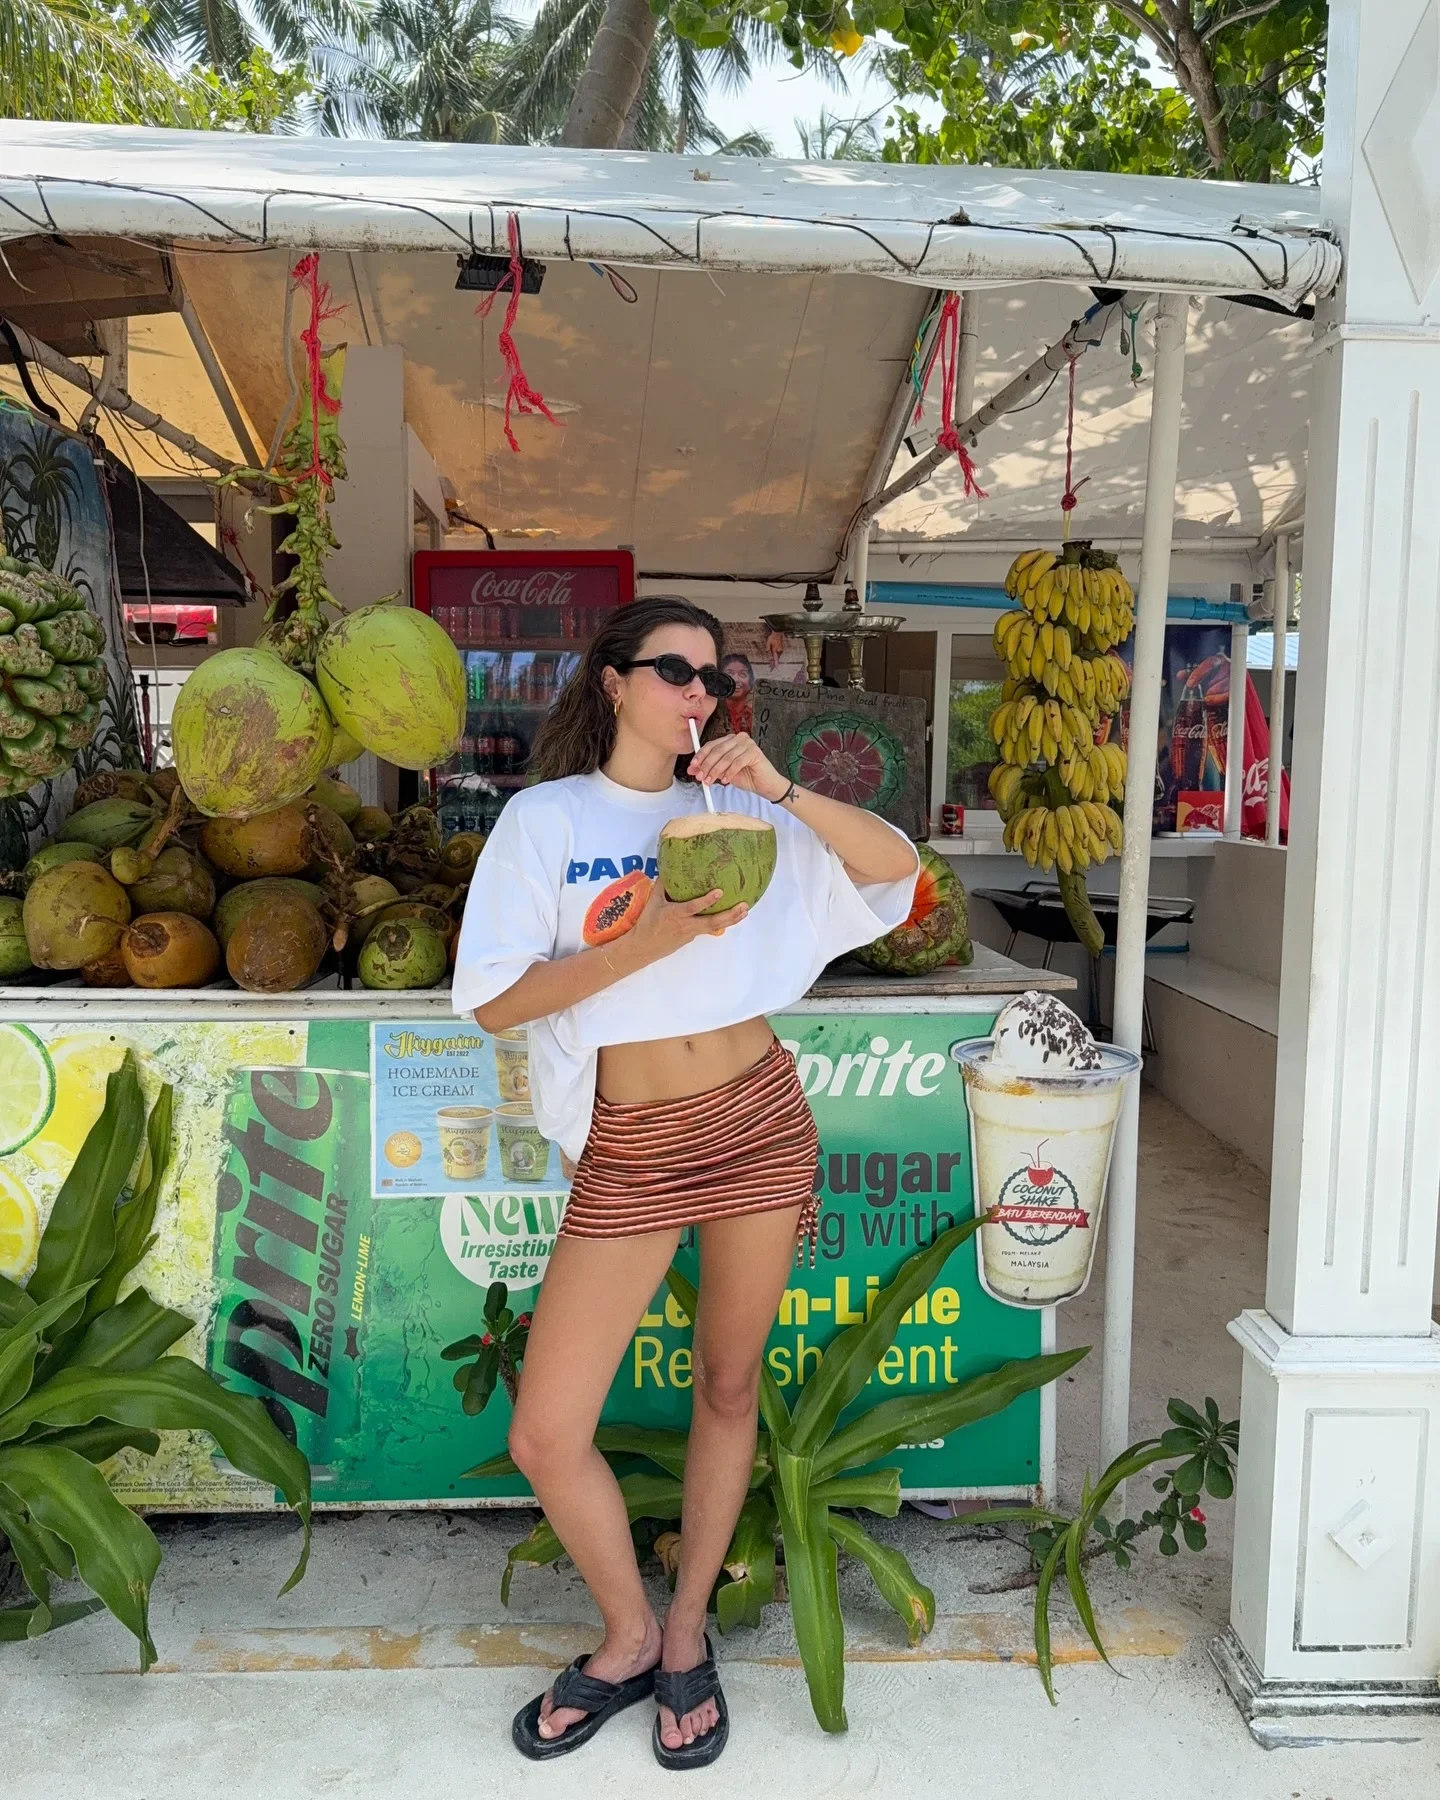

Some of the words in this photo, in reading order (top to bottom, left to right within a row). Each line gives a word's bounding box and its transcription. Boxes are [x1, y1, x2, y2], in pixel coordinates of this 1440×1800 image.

[470, 571, 577, 606] Coca-Cola
[758, 681, 811, 699] Screw
[813, 686, 846, 702] Pine
[855, 694, 878, 706] local
[387, 1066, 480, 1080] HOMEMADE
[392, 1084, 417, 1097] ICE
[421, 1084, 475, 1097] CREAM
[1012, 1184, 1067, 1196] COCONUT
[1014, 1195, 1060, 1206] SHAKE
[860, 1200, 955, 1247] with
[995, 1208, 1023, 1219] BATU
[1022, 1210, 1081, 1222] BERENDAM
[316, 1190, 349, 1299] SUGAR
[488, 1260, 539, 1279] Taste
[1011, 1260, 1050, 1268] MALAYSIA
[351, 1232, 372, 1321] LEMON-LIME
[306, 1296, 338, 1381] ZERO
